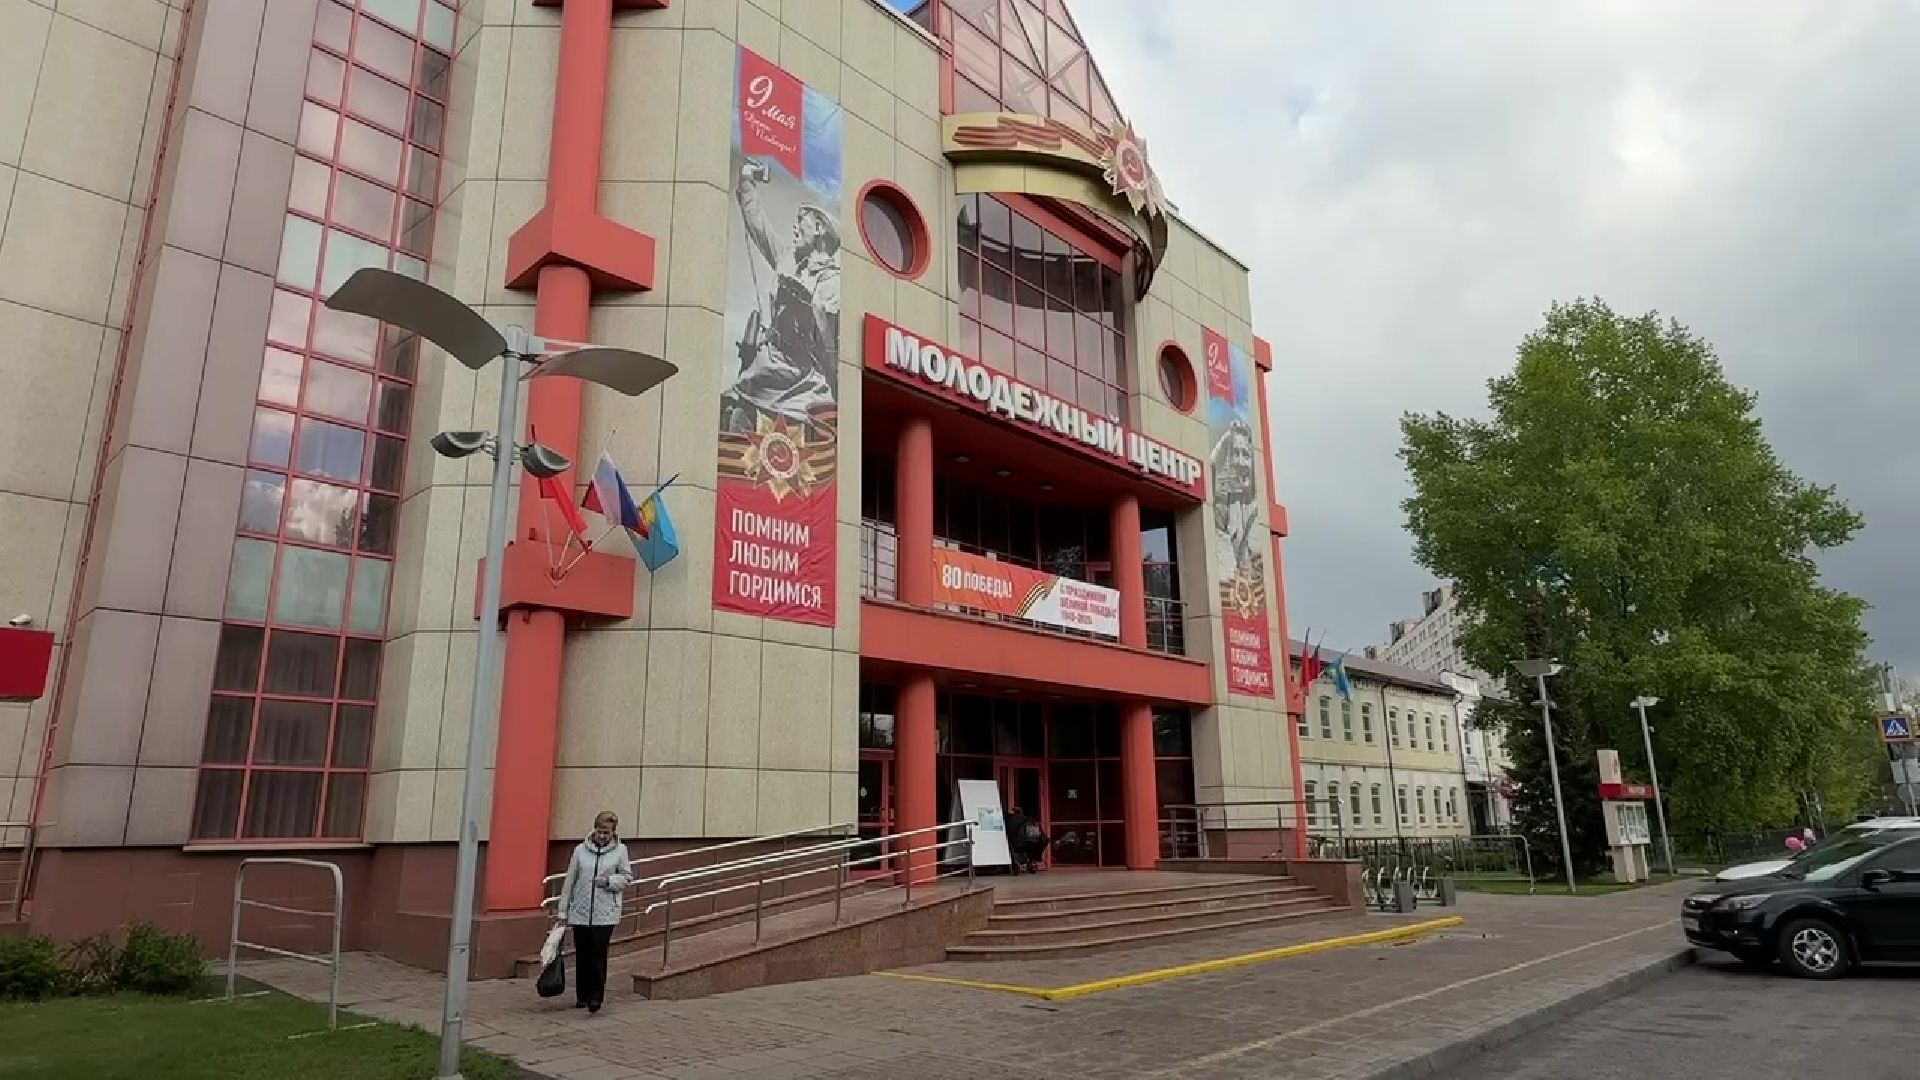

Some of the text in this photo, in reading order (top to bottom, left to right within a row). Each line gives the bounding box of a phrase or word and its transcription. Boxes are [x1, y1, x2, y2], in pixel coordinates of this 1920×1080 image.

[747, 76, 796, 130] 9 Мая
[885, 327, 1201, 486] МОЛОДЕЖНЫЙ ЦЕНТР
[732, 508, 809, 548] ПОМНИМ
[729, 540, 798, 576] ЛЮБИМ
[729, 571, 821, 609] ГОРДИМСЯ
[942, 565, 1012, 598] 80 ПОБЕДА!
